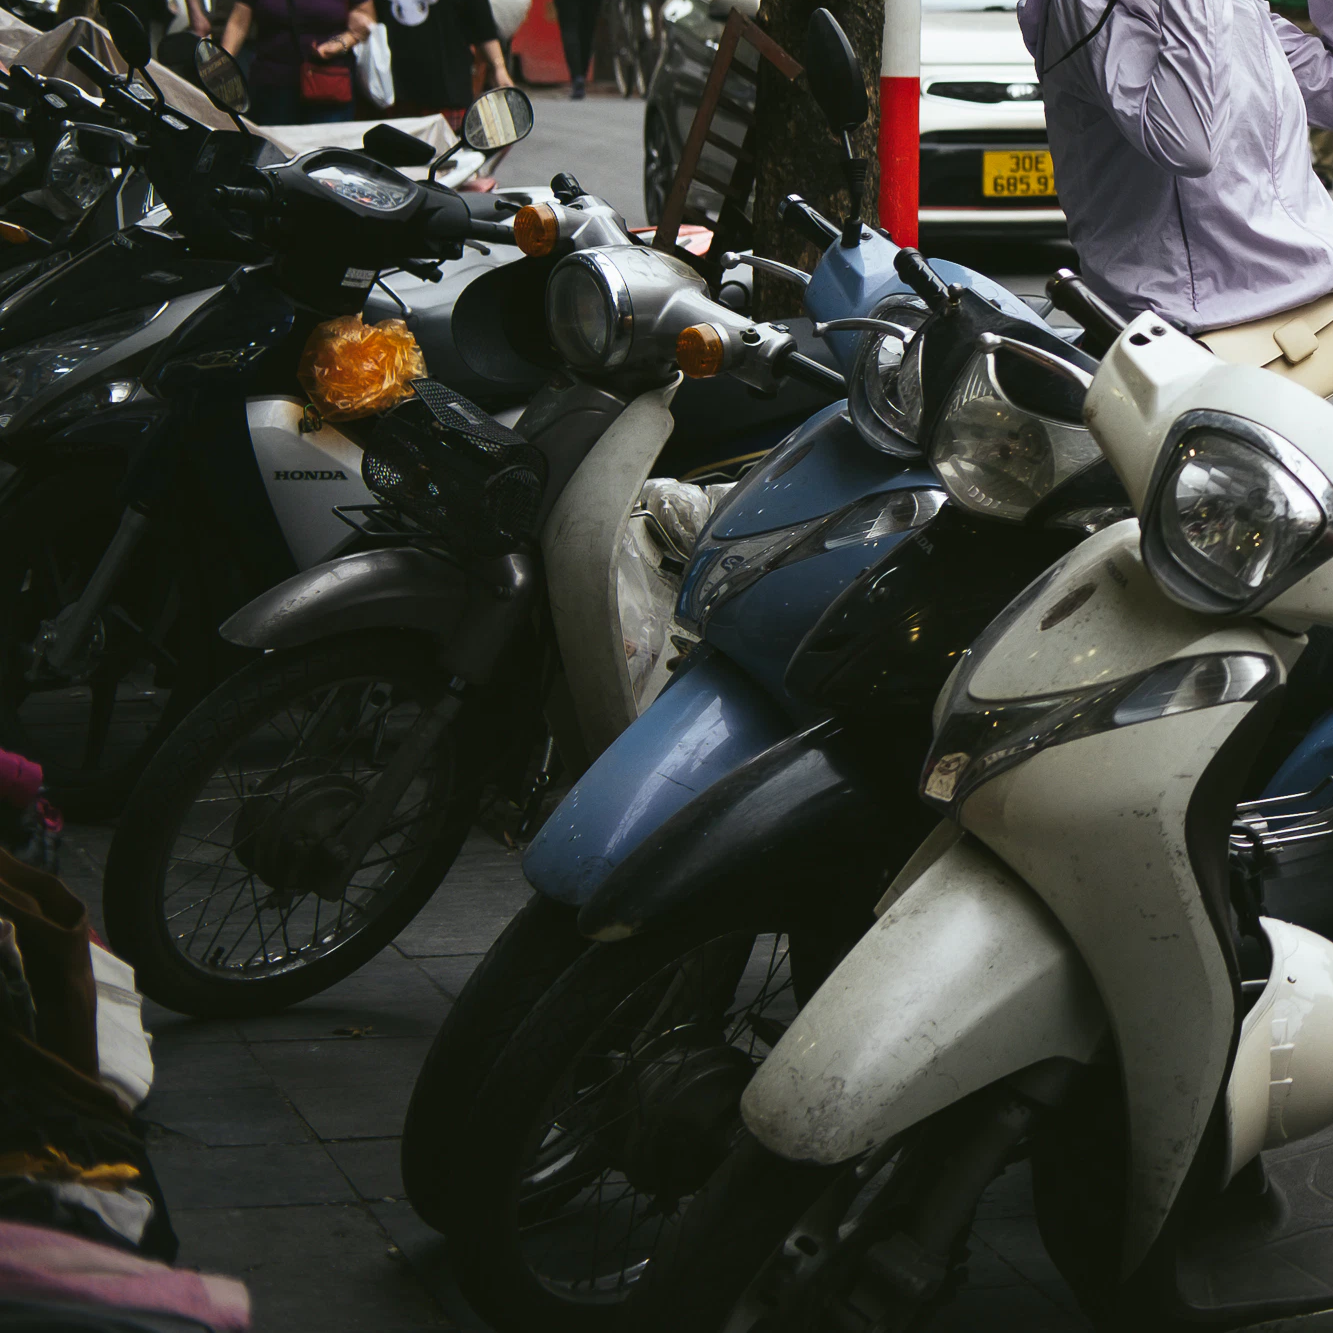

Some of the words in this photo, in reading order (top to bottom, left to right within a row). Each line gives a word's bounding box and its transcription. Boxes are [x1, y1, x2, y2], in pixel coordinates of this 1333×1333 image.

[1009, 153, 1046, 173] 30E
[993, 175, 1056, 195] 685.9
[274, 470, 348, 481] HONDA
